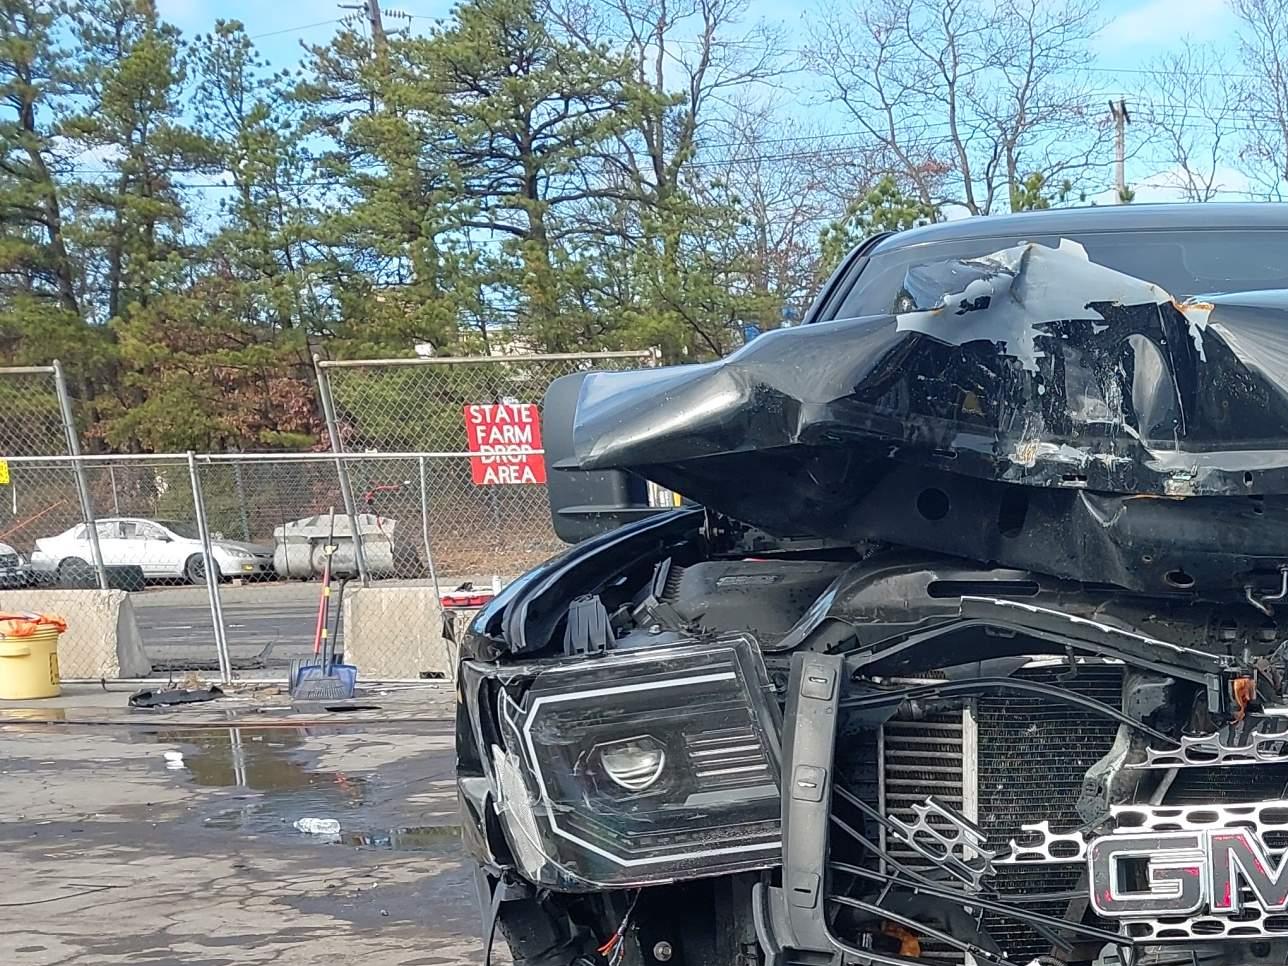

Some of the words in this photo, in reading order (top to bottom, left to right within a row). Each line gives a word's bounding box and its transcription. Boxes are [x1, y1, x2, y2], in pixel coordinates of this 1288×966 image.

[470, 403, 532, 424] STATE
[476, 424, 532, 444] FARM
[479, 444, 532, 464] DROP
[483, 465, 537, 484] AREA
